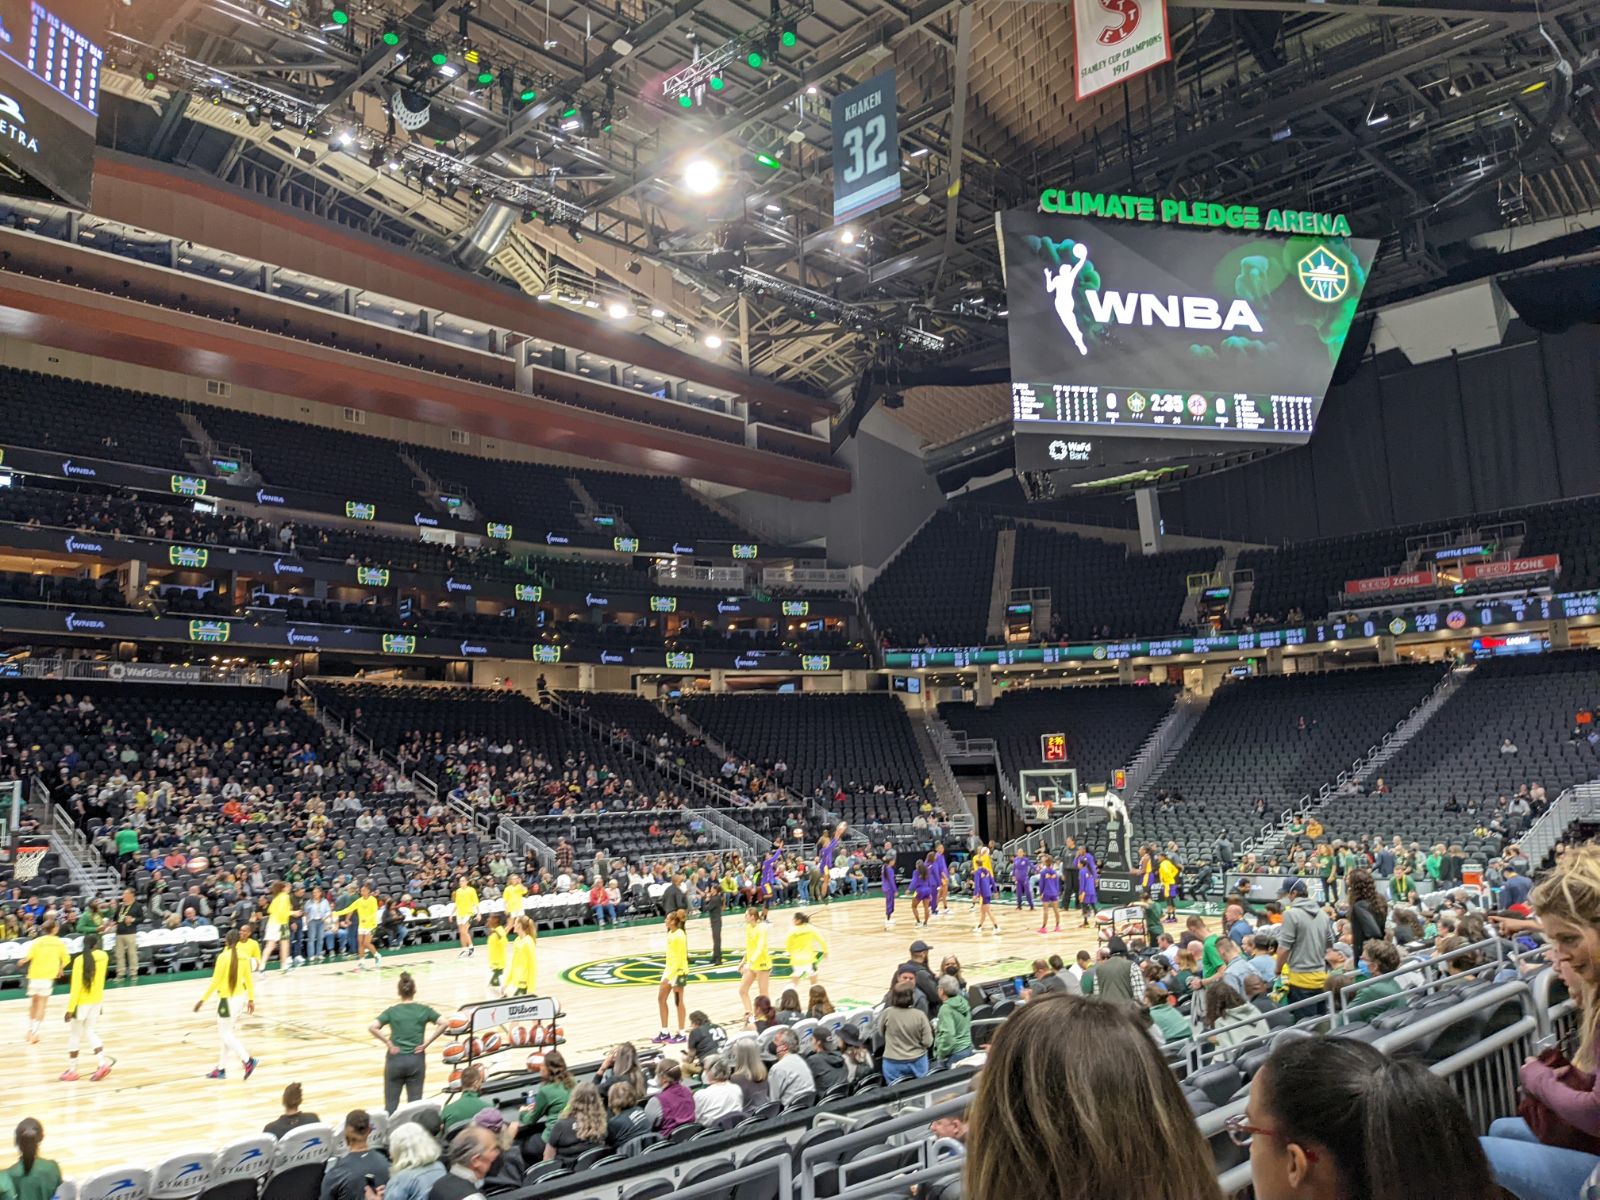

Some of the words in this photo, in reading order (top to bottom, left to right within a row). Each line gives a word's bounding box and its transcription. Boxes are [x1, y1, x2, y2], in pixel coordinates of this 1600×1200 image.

[1081, 60, 1107, 78] STANLEY
[1108, 53, 1121, 65] CUP
[1122, 33, 1162, 58] CHAMPIONS
[1113, 60, 1130, 76] 1917
[845, 90, 881, 121] KRAKEN
[843, 114, 887, 183] 32
[1039, 188, 1155, 221] CLIMATE
[1161, 199, 1261, 231] PLEDGE
[1264, 208, 1352, 237] ARENA
[1085, 289, 1263, 333] WNBA
[1067, 441, 1091, 453] WaFd
[1069, 451, 1089, 460] Bank
[69, 466, 96, 477] WNBA
[72, 541, 102, 552] WNBA
[1513, 559, 1545, 571] ZONE
[1393, 575, 1420, 586] ZONE
[1415, 613, 1438, 627] 2:35
[1481, 608, 1492, 625] 0
[72, 620, 105, 629] WNBA
[1364, 621, 1374, 637] 0
[175, 671, 200, 680] CLUB
[1047, 745, 1063, 759] 24
[1102, 881, 1129, 889] BECU
[508, 1004, 539, 1016] Wilson
[281, 1147, 329, 1164] SYMETRA
[220, 1158, 270, 1175] SYMETRA
[158, 1173, 210, 1189] SYMETRA
